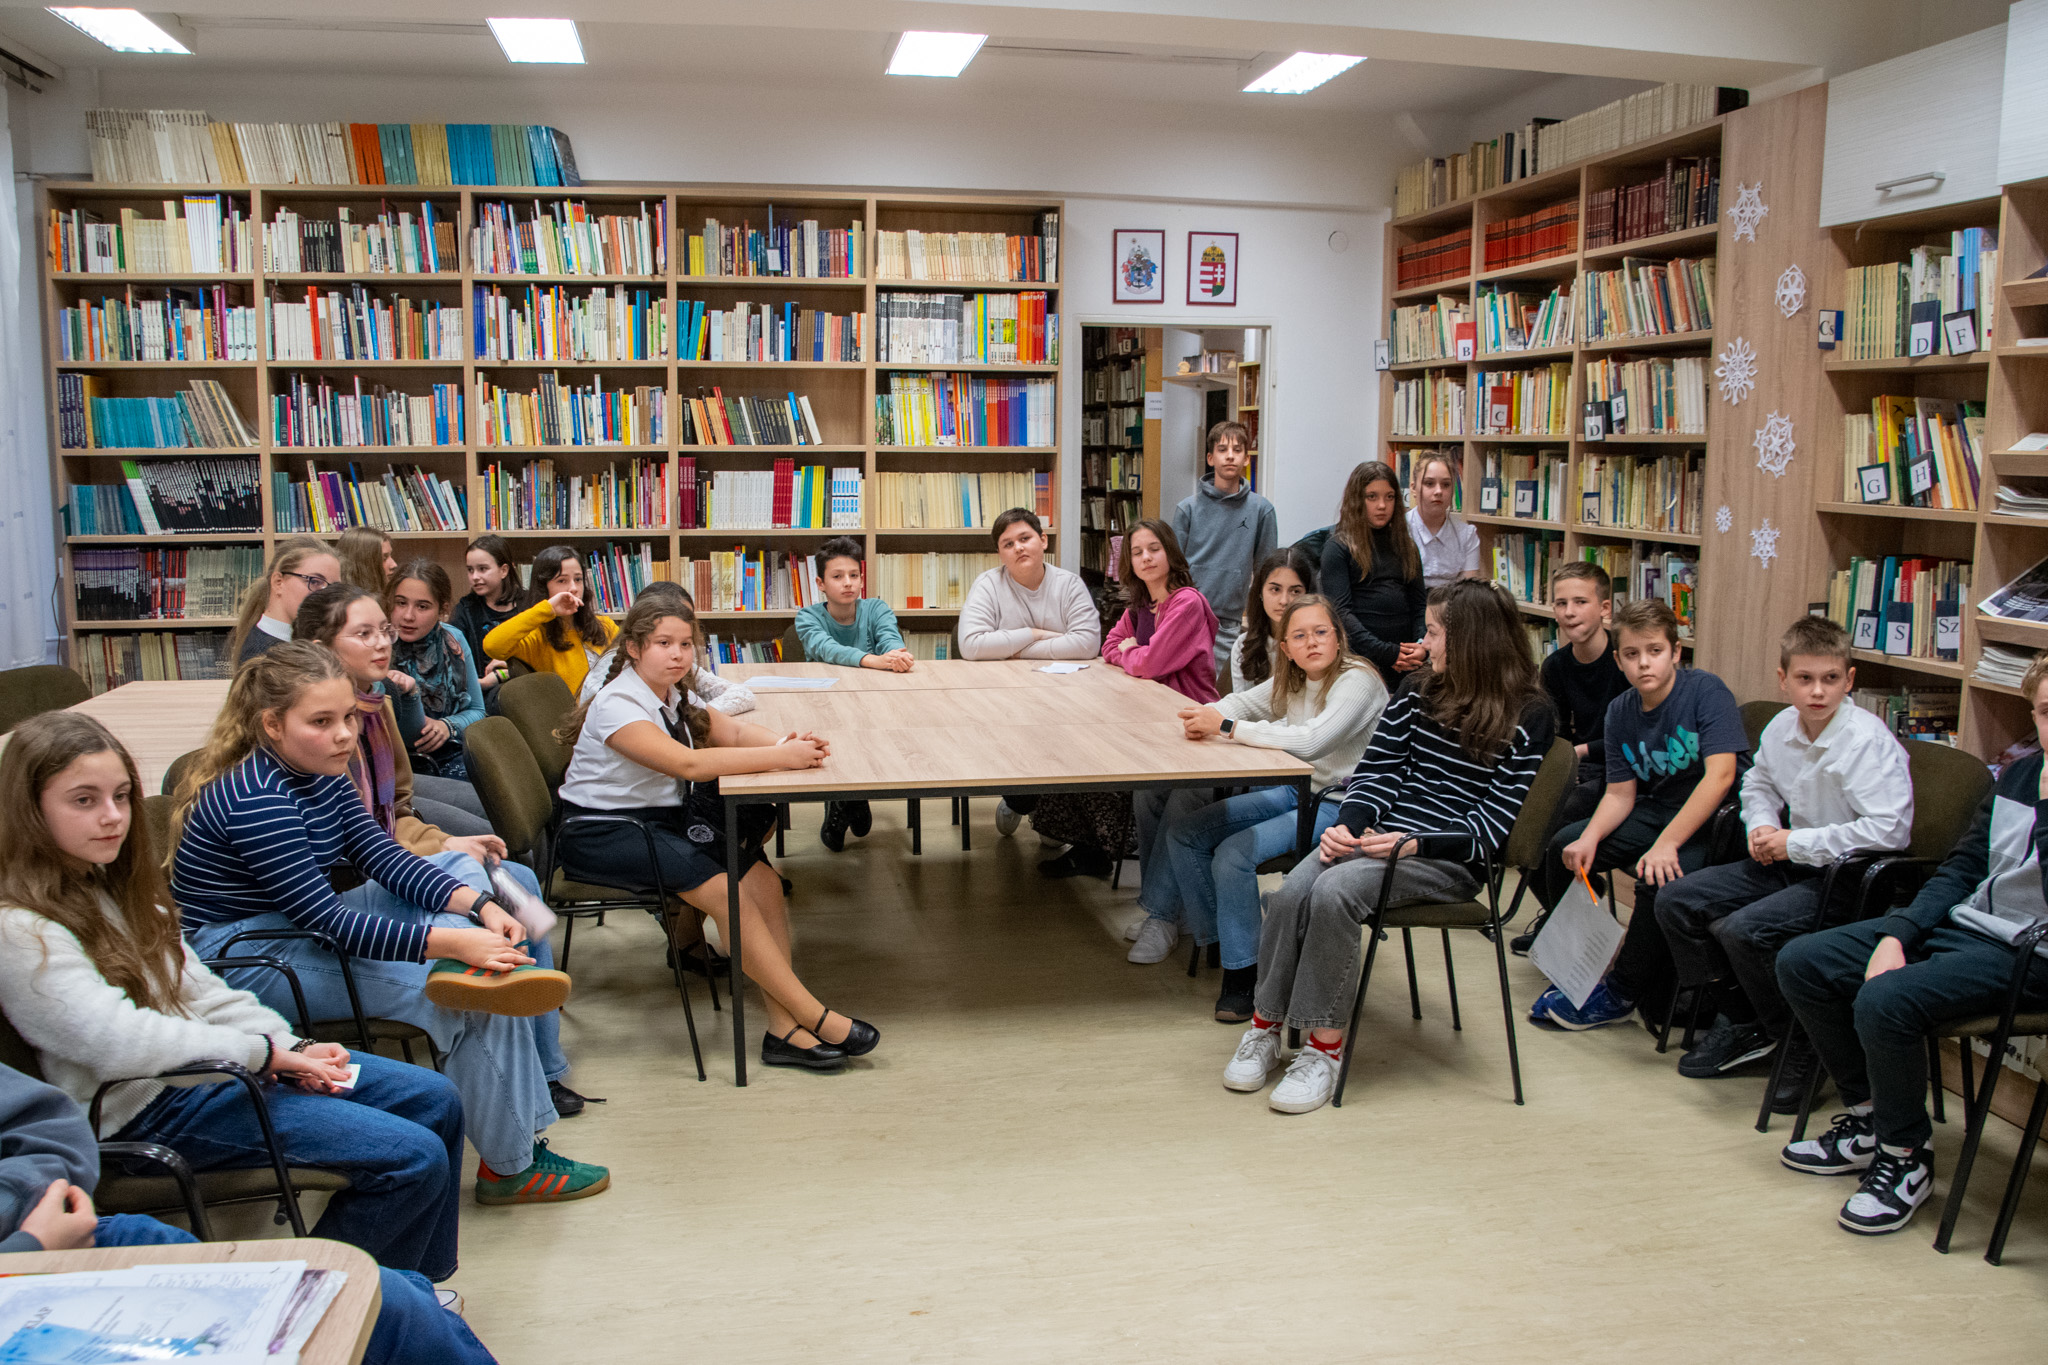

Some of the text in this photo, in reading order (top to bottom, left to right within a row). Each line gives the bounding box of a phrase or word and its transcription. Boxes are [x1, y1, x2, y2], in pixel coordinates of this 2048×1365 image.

[1819, 320, 1835, 336] Cs
[1955, 328, 1967, 346] F
[1462, 346, 1471, 357] B
[1916, 338, 1929, 354] D
[1377, 355, 1387, 366] A
[1616, 401, 1623, 414] E
[1494, 411, 1505, 422] C
[1589, 424, 1601, 437] D
[1915, 466, 1927, 483] H
[1867, 479, 1881, 495] G
[1486, 490, 1491, 501] I
[1518, 493, 1526, 503] J
[1587, 508, 1597, 519] K
[1860, 622, 1871, 638] R
[1894, 625, 1905, 641] S
[1939, 618, 1959, 634] Sz
